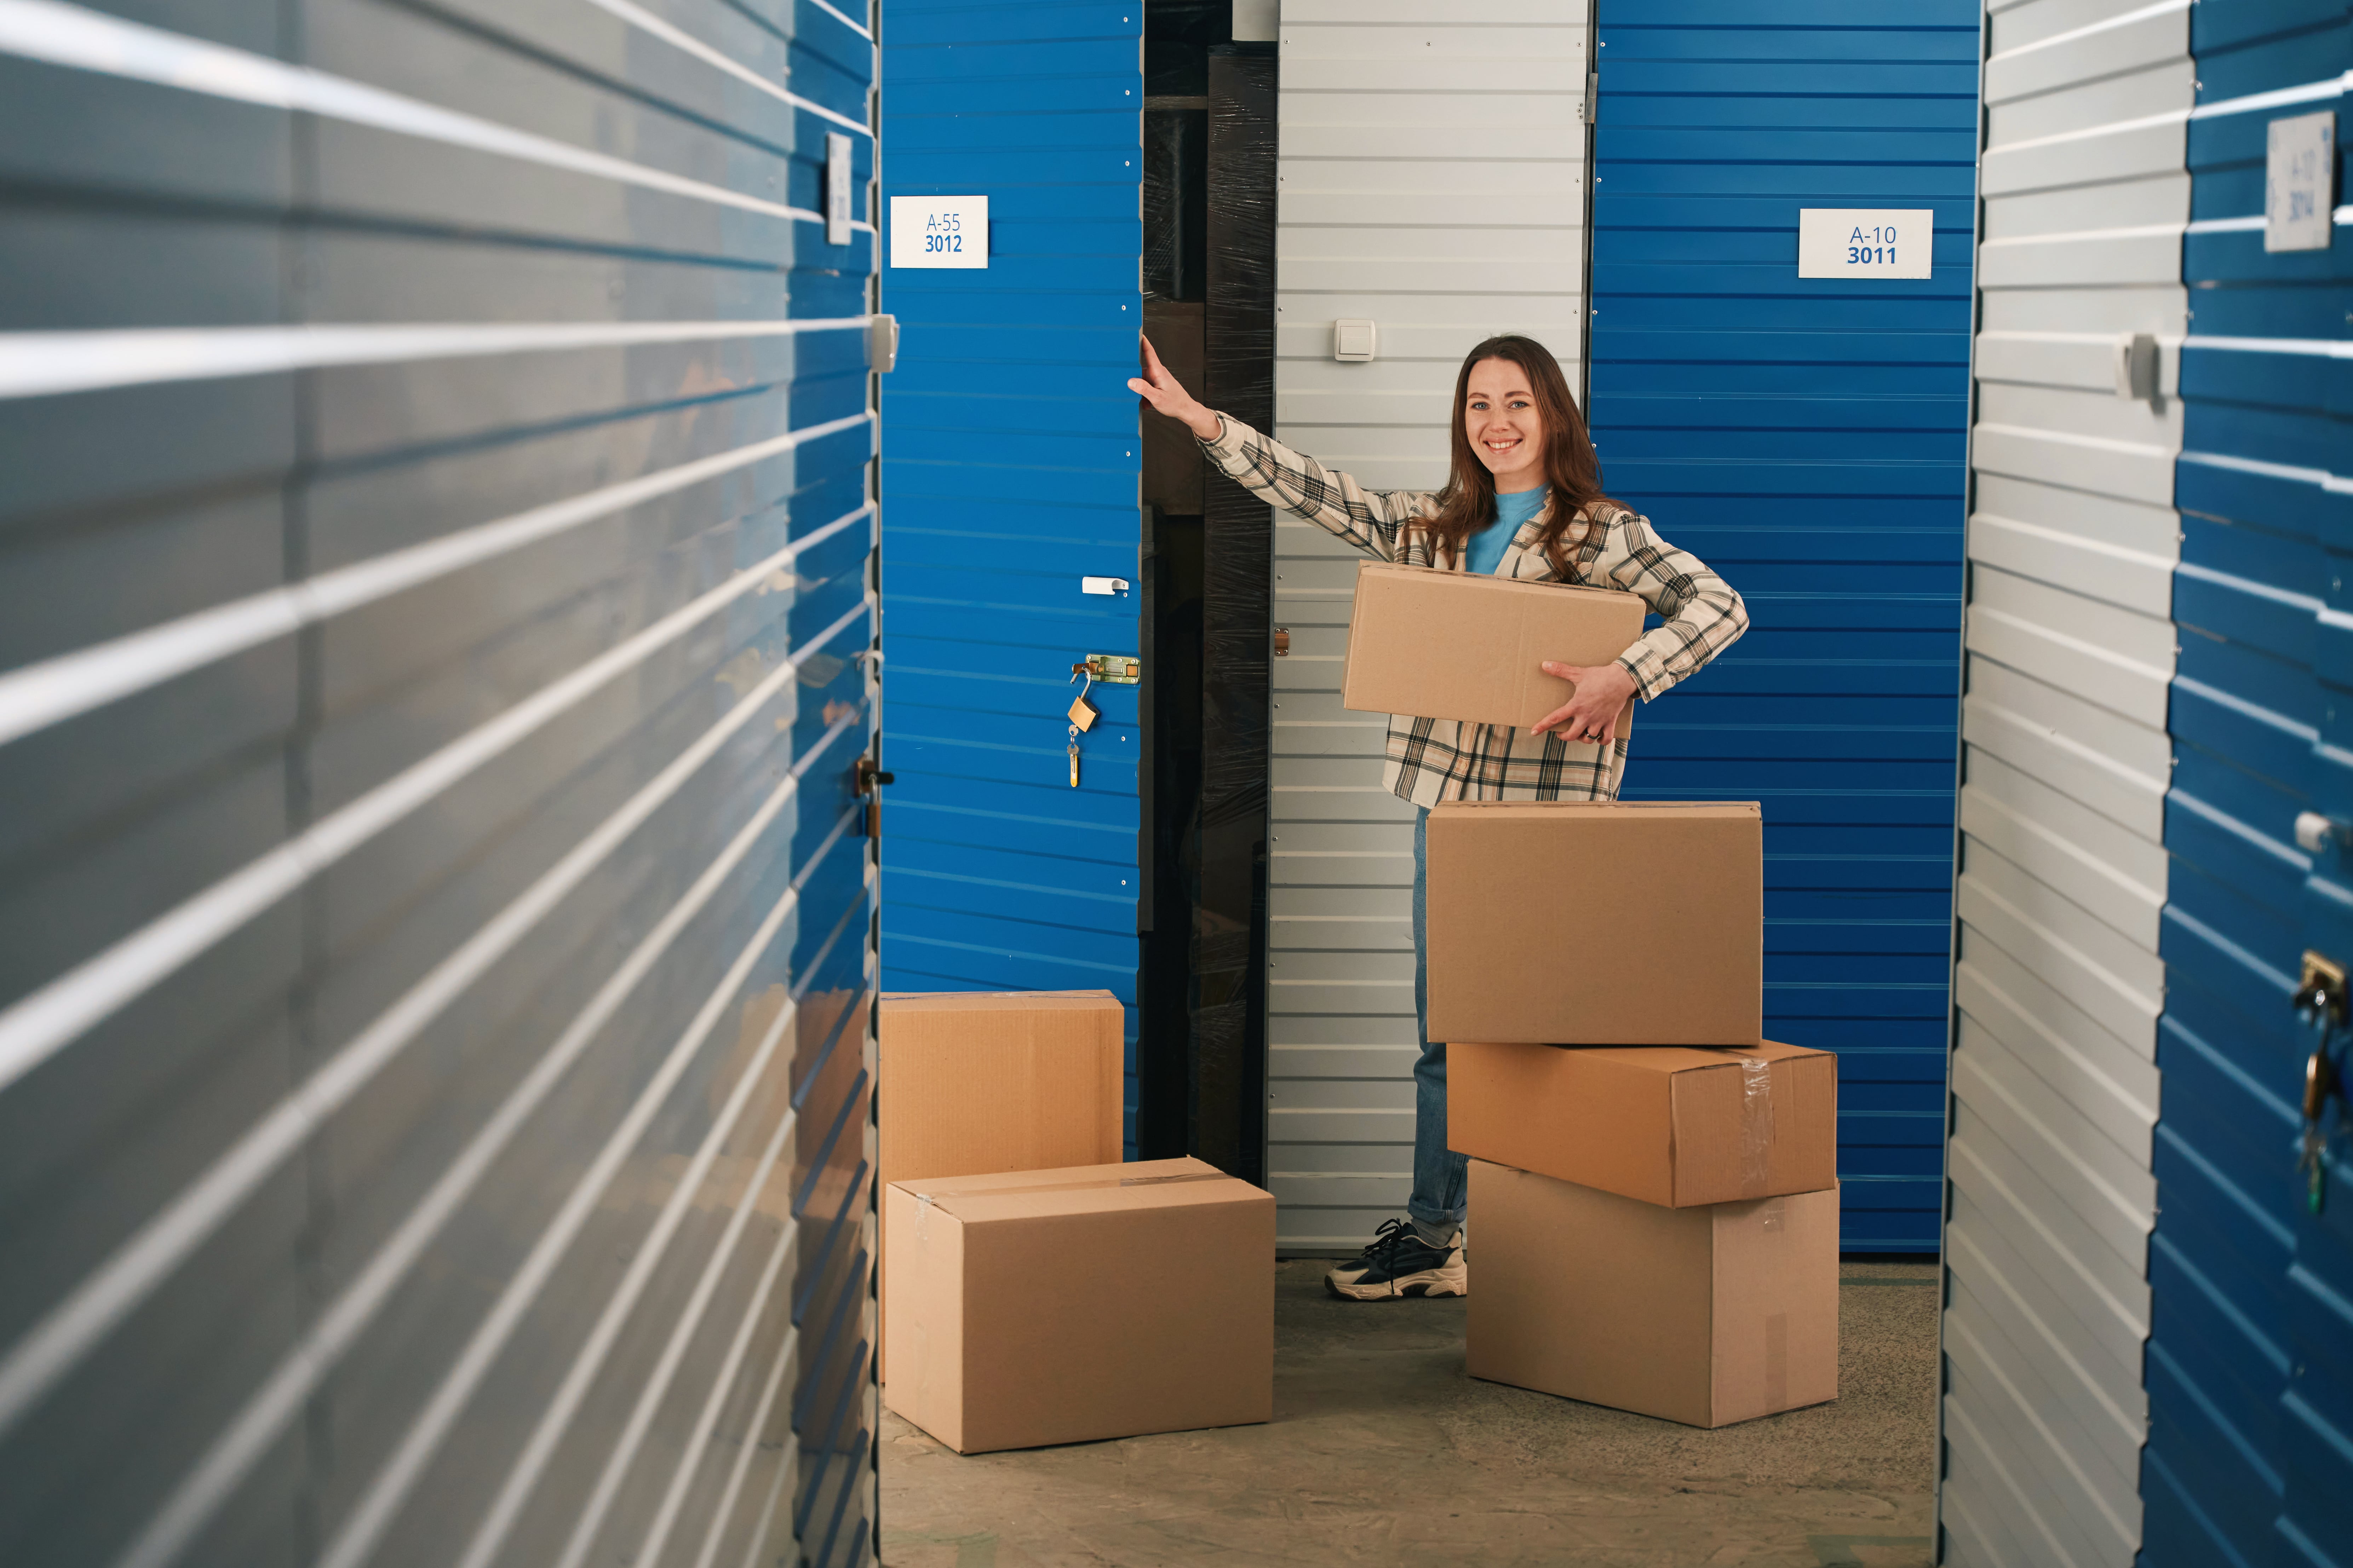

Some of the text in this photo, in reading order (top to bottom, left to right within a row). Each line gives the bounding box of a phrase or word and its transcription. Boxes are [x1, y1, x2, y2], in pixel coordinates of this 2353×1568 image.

[927, 214, 960, 231] A-55
[925, 235, 962, 252] 3012
[1849, 226, 1896, 244] A-10
[1847, 247, 1895, 264] 3011
